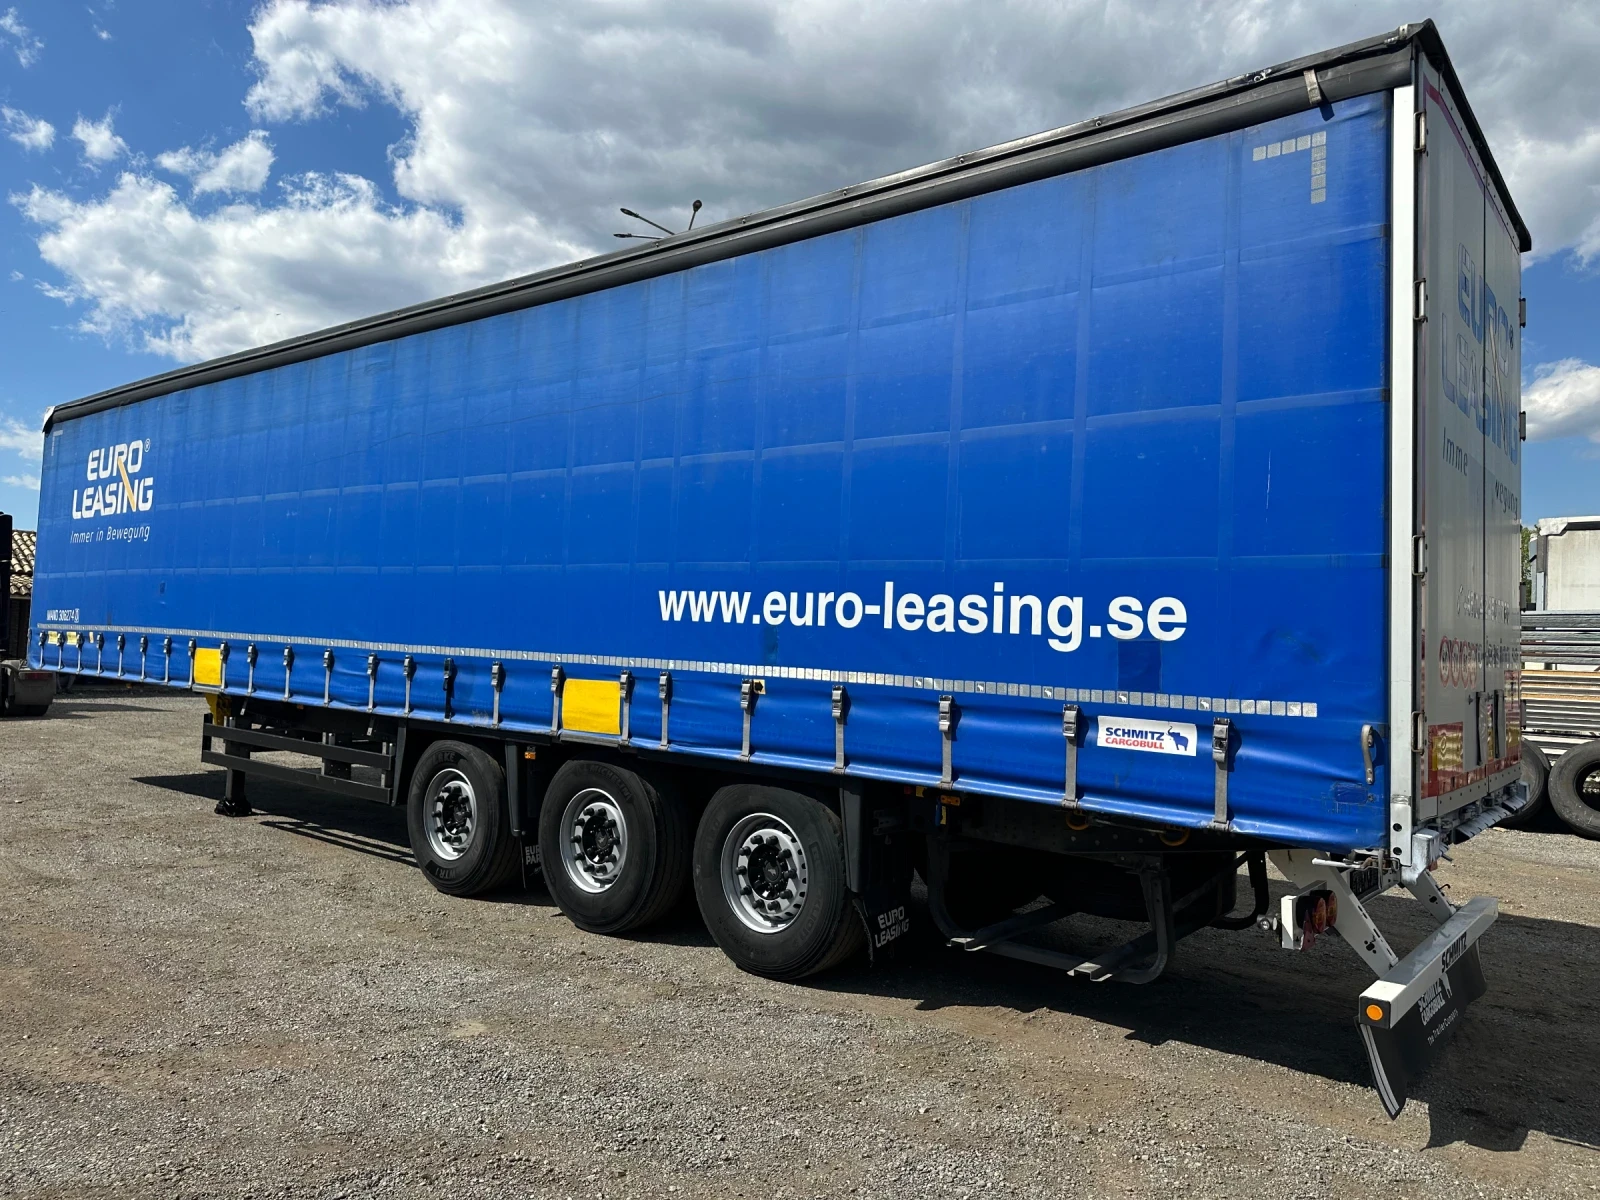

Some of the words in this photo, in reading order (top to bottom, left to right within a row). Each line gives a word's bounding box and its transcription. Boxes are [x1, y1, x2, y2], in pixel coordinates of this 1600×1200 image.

[1458, 243, 1509, 378] EURO
[1442, 312, 1518, 465] LEASING
[87, 440, 143, 481] EURO
[1442, 427, 1468, 476] Imme
[72, 477, 154, 520] LEASING
[70, 530, 94, 544] Immer
[96, 527, 104, 541] in
[106, 525, 150, 543] Bewegung
[658, 581, 1188, 653] www.euro-leasing.se
[1105, 727, 1165, 741] SCHMITZ
[1105, 737, 1165, 750] CARGOBULL
[524, 844, 540, 856] EUR
[525, 854, 542, 866] PAR
[874, 918, 910, 948] LEASING
[877, 905, 905, 930] EURO
[1441, 931, 1467, 973] SCHMITZ
